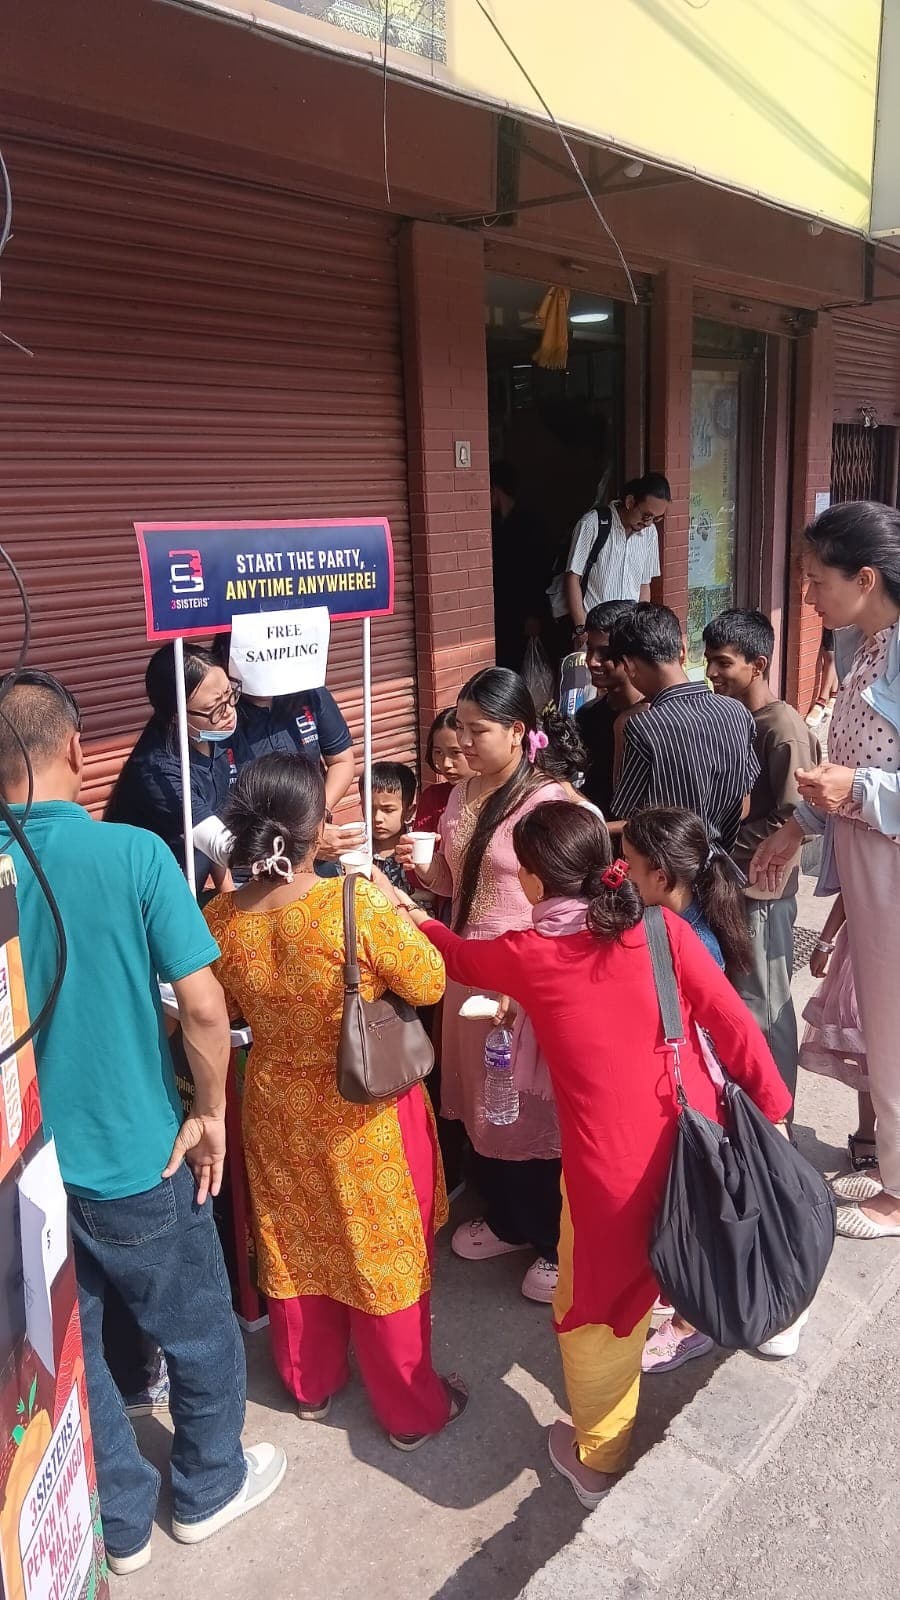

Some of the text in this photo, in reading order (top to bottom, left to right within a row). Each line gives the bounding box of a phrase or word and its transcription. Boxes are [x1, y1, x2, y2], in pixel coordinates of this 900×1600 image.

[236, 549, 365, 574] START THE PARTY,
[226, 572, 376, 601] ANYTIME ANYWHERE!
[267, 624, 302, 639] FREE
[245, 643, 319, 663] SAMPLING
[30, 1412, 73, 1527] 3SISTERS
[27, 1437, 82, 1592] PEACH MANGO
[49, 1504, 70, 1577] MALT
